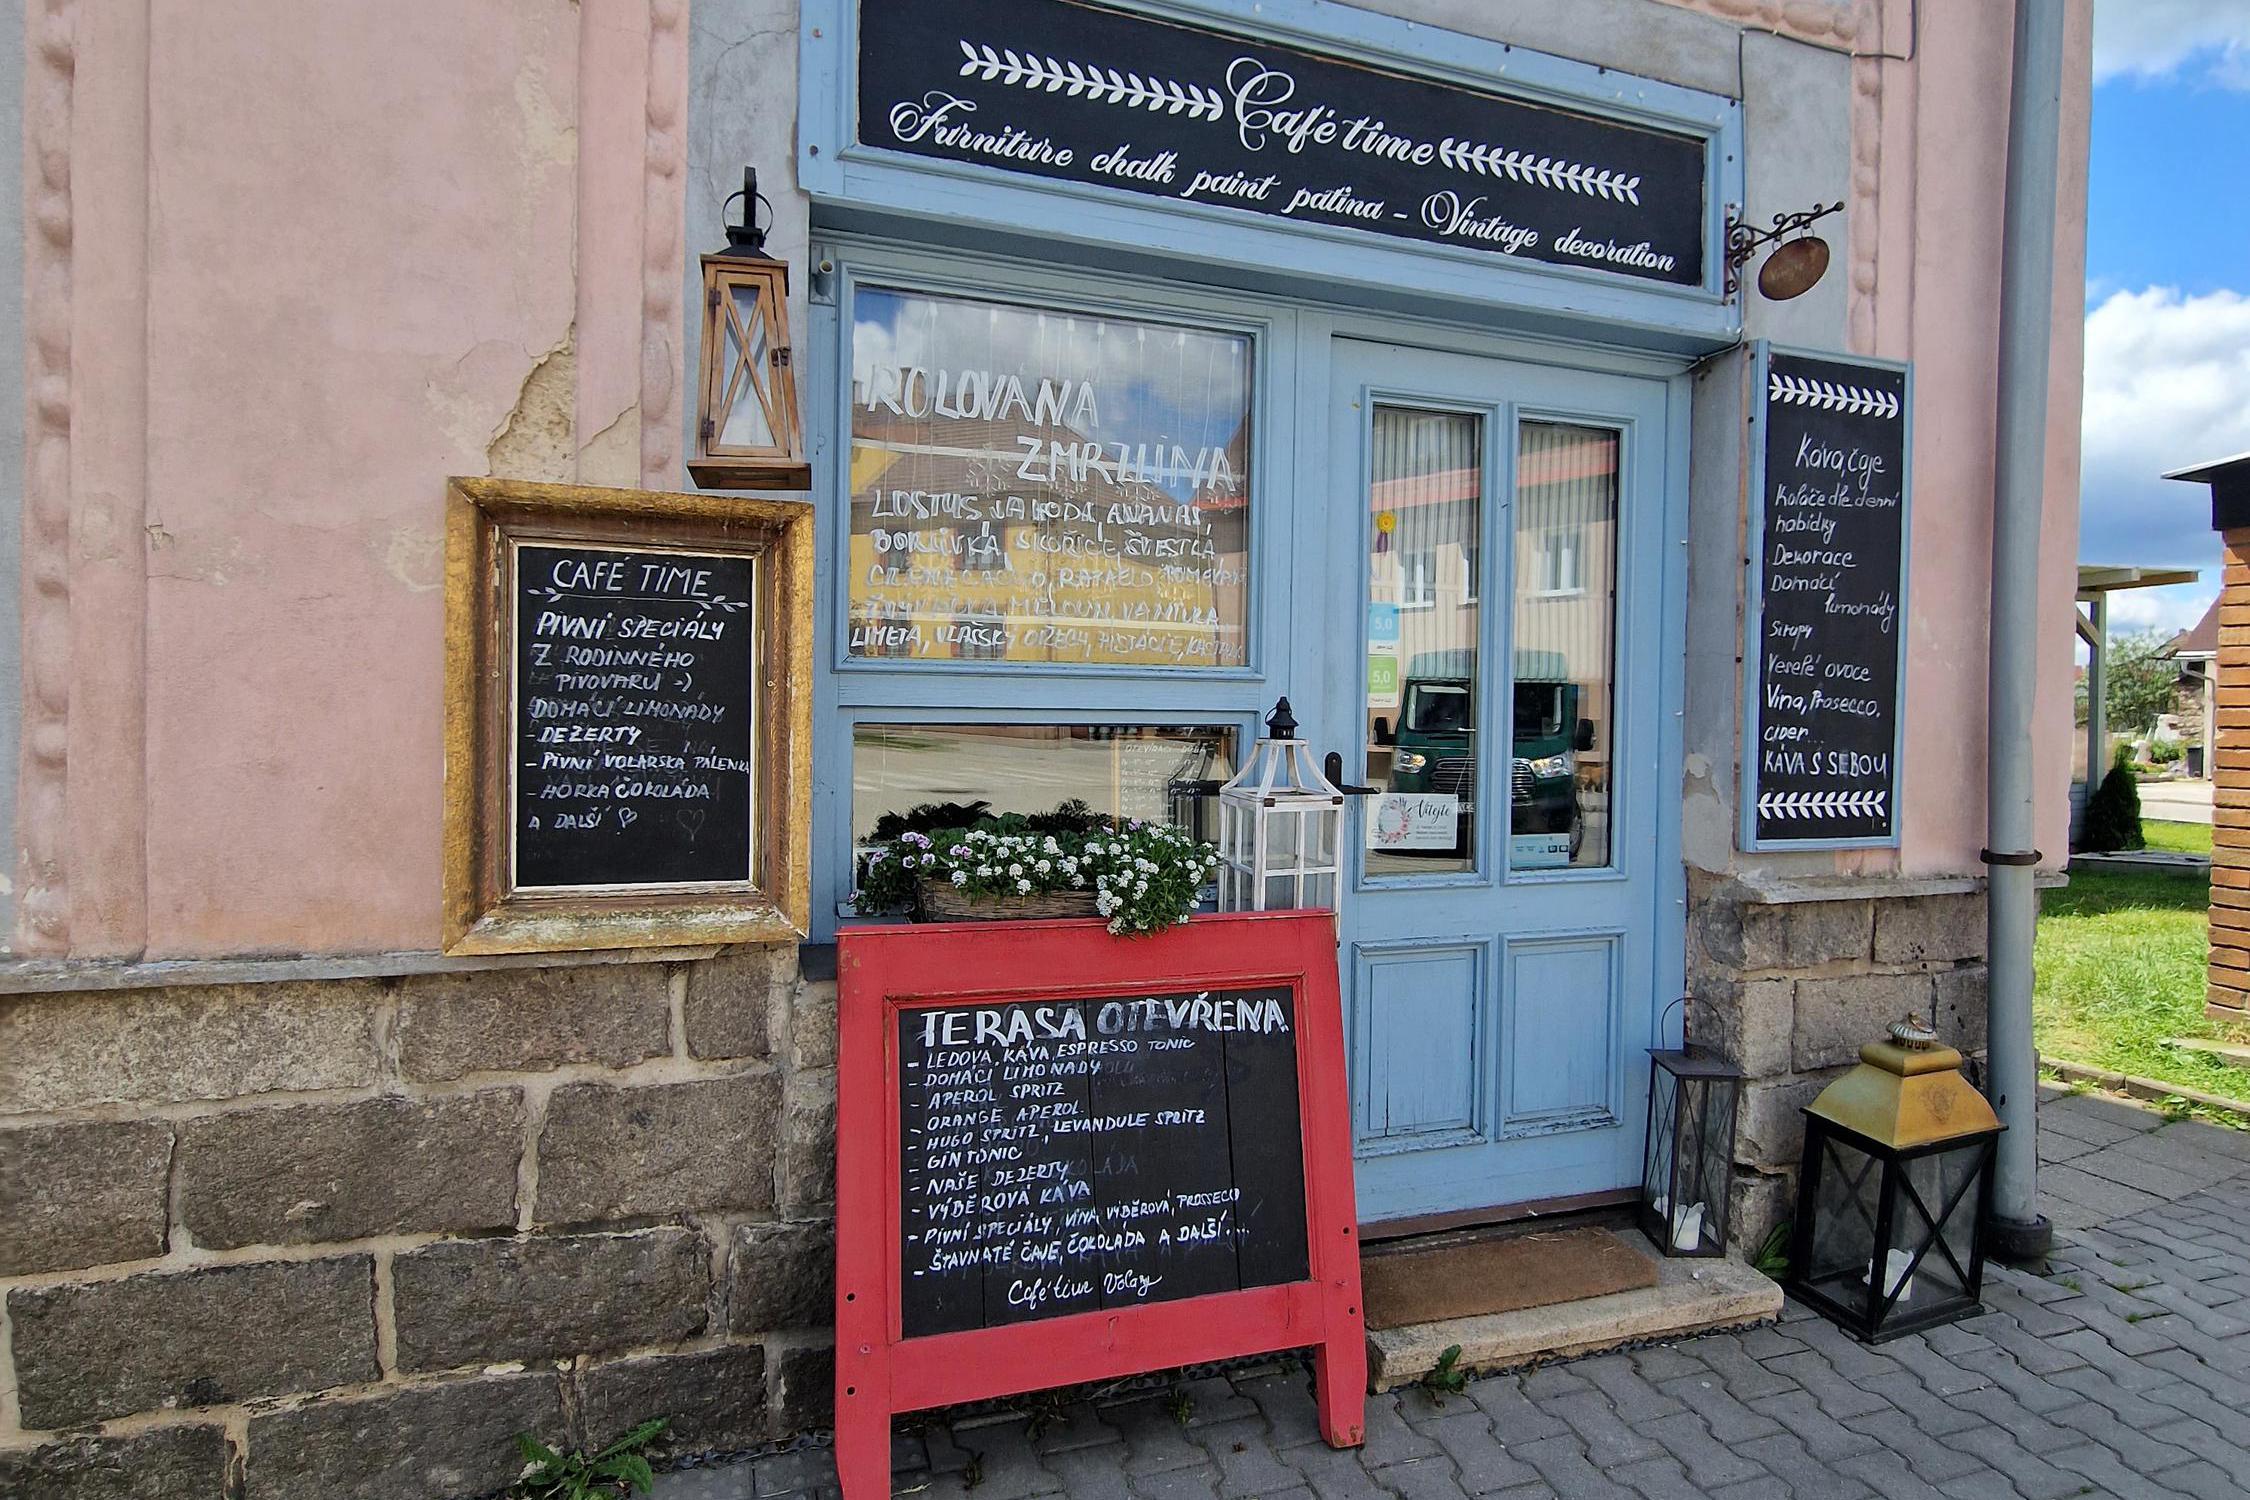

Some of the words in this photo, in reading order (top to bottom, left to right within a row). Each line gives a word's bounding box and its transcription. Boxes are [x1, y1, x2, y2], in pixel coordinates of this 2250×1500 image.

[1226, 56, 1337, 152] Café
[1342, 118, 1436, 166] time
[889, 90, 1074, 167] Furniture
[1091, 144, 1178, 184] chalk
[1182, 169, 1280, 201] paint
[1280, 181, 1382, 219] patina
[1421, 190, 1539, 253] Vintage
[1555, 225, 1676, 273] decoration
[1017, 435, 1236, 491] ZMRZLINA
[1795, 432, 1845, 478] Káva,
[1848, 448, 1886, 490] čaje
[1828, 482, 1853, 507] dle
[1854, 490, 1900, 508] denní
[1776, 512, 1836, 544] nabídky
[1772, 544, 1858, 568] Dekorace
[552, 557, 630, 592] CAFÉ
[640, 561, 712, 597] TIME
[1771, 572, 1840, 592] Domácí
[536, 611, 612, 640] PIVNÍ
[618, 611, 725, 641] SPECIÁLY
[1825, 590, 1896, 634] limonády
[1769, 621, 1813, 651] Sirupy
[532, 643, 552, 666] Z
[561, 644, 695, 668] RODINNÉHO
[1768, 653, 1822, 680] Veselé
[1825, 663, 1872, 682] ovoce
[556, 672, 661, 691] PIVOVARU
[1373, 669, 1391, 685] 5,0
[530, 693, 623, 719] DOMÁCÍ
[623, 693, 725, 724] LIMONÁDY
[537, 726, 642, 745] DEZERTY
[541, 749, 601, 770] PIVNÍ
[694, 746, 749, 773] PÁLENKA
[1764, 743, 1805, 775] KÁVA
[1827, 751, 1888, 779] SEBOU
[615, 777, 710, 799] ČOKOLÁDA
[554, 805, 612, 829] DALŠÍ
[920, 1007, 1086, 1048] TERASA
[1096, 991, 1289, 1034] OTEVŘENA
[1057, 1039, 1138, 1058] ESPRESSO
[1148, 1036, 1196, 1051] TONIC
[928, 1089, 997, 1110] APEROL
[1009, 1082, 1066, 1099] SPRITZ
[926, 1132, 974, 1151] HUGO
[1053, 1112, 1150, 1134] LEVANDULE
[1154, 1109, 1206, 1126] SPRITZ
[927, 1108, 1003, 1131] ORANGE
[927, 1151, 961, 1169] GIN
[967, 1146, 1023, 1164] TONIC
[926, 1171, 978, 1196] NAŠE
[991, 1161, 1069, 1187] DEZERTY
[928, 1184, 1031, 1220] VÝBĚROVÁ
[1040, 1179, 1091, 1206] KÁVA
[924, 1222, 970, 1245] PIVNÍ
[1067, 1221, 1146, 1256] ČOKOLÁDA
[1159, 1228, 1170, 1246] A
[1008, 1277, 1051, 1310] Café
